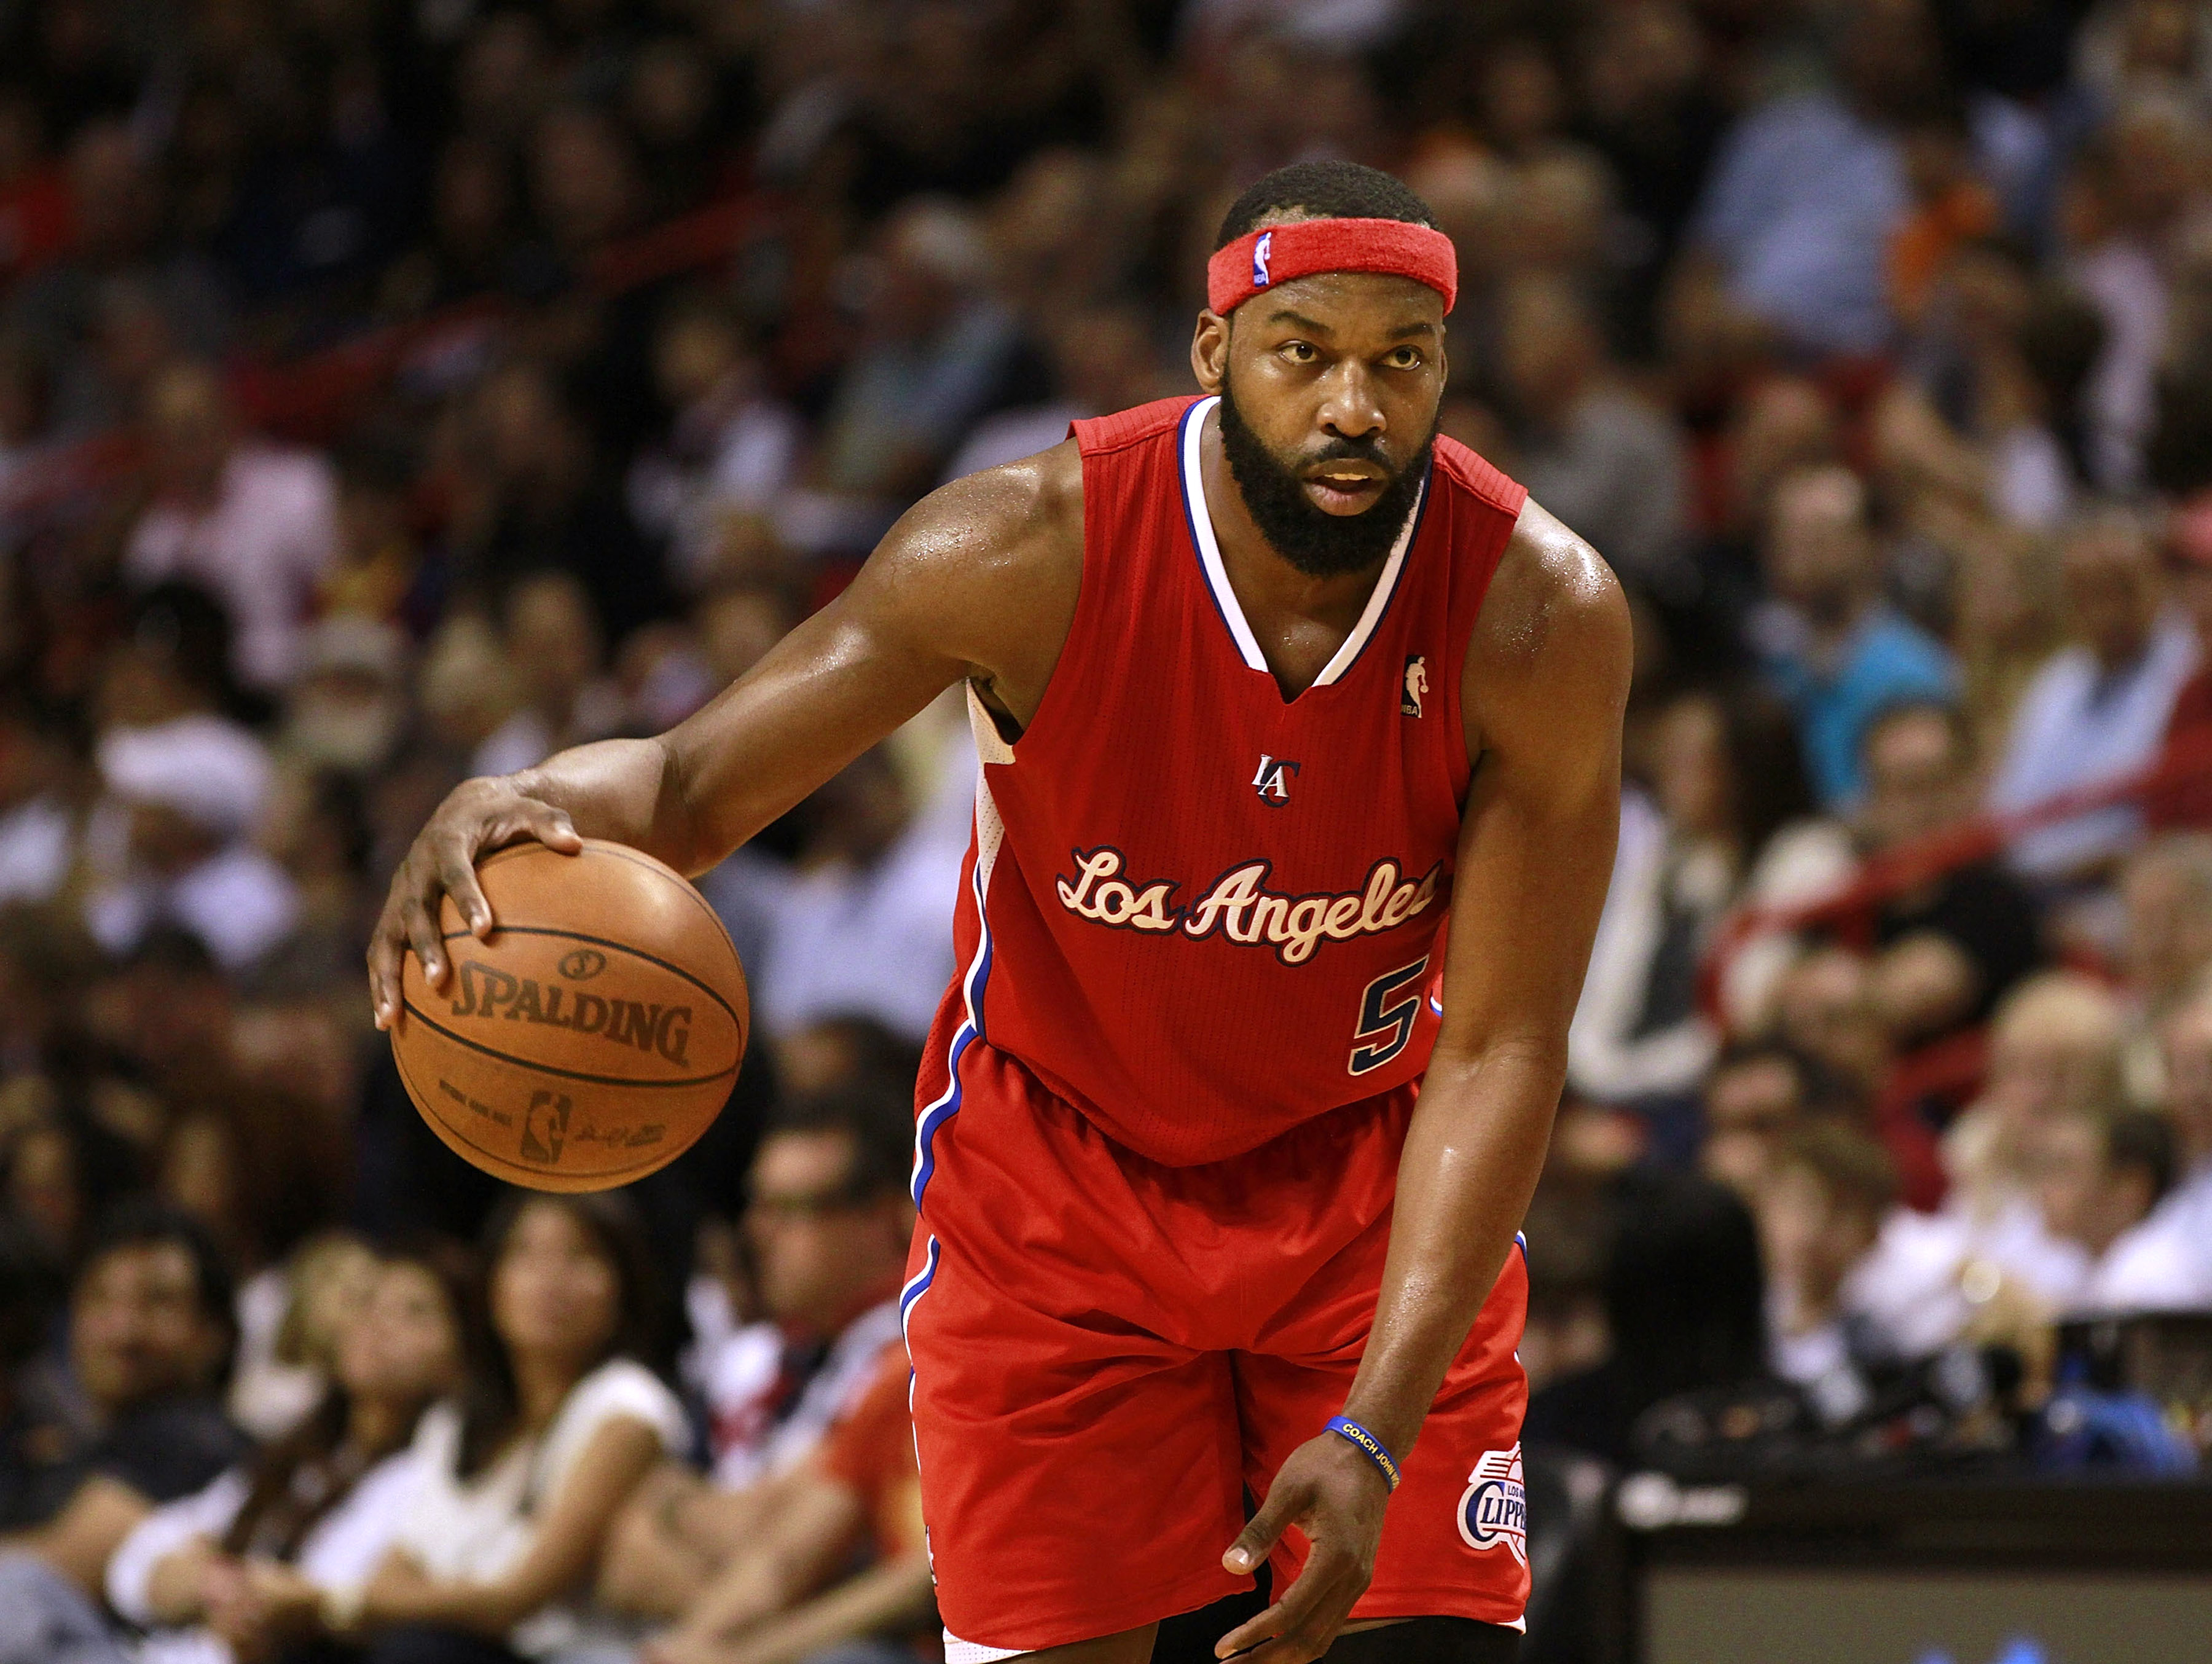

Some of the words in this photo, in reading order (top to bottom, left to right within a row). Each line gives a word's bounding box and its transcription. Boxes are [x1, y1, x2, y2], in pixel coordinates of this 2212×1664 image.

[1056, 846, 1181, 933] Los
[1185, 858, 1443, 967] Angeles
[452, 960, 692, 1068] SPALDING
[1347, 954, 1430, 1076] 5
[1343, 1424, 1378, 1454] COACH
[1376, 1453, 1395, 1475] JOHN
[1508, 1485, 1518, 1497] LOS
